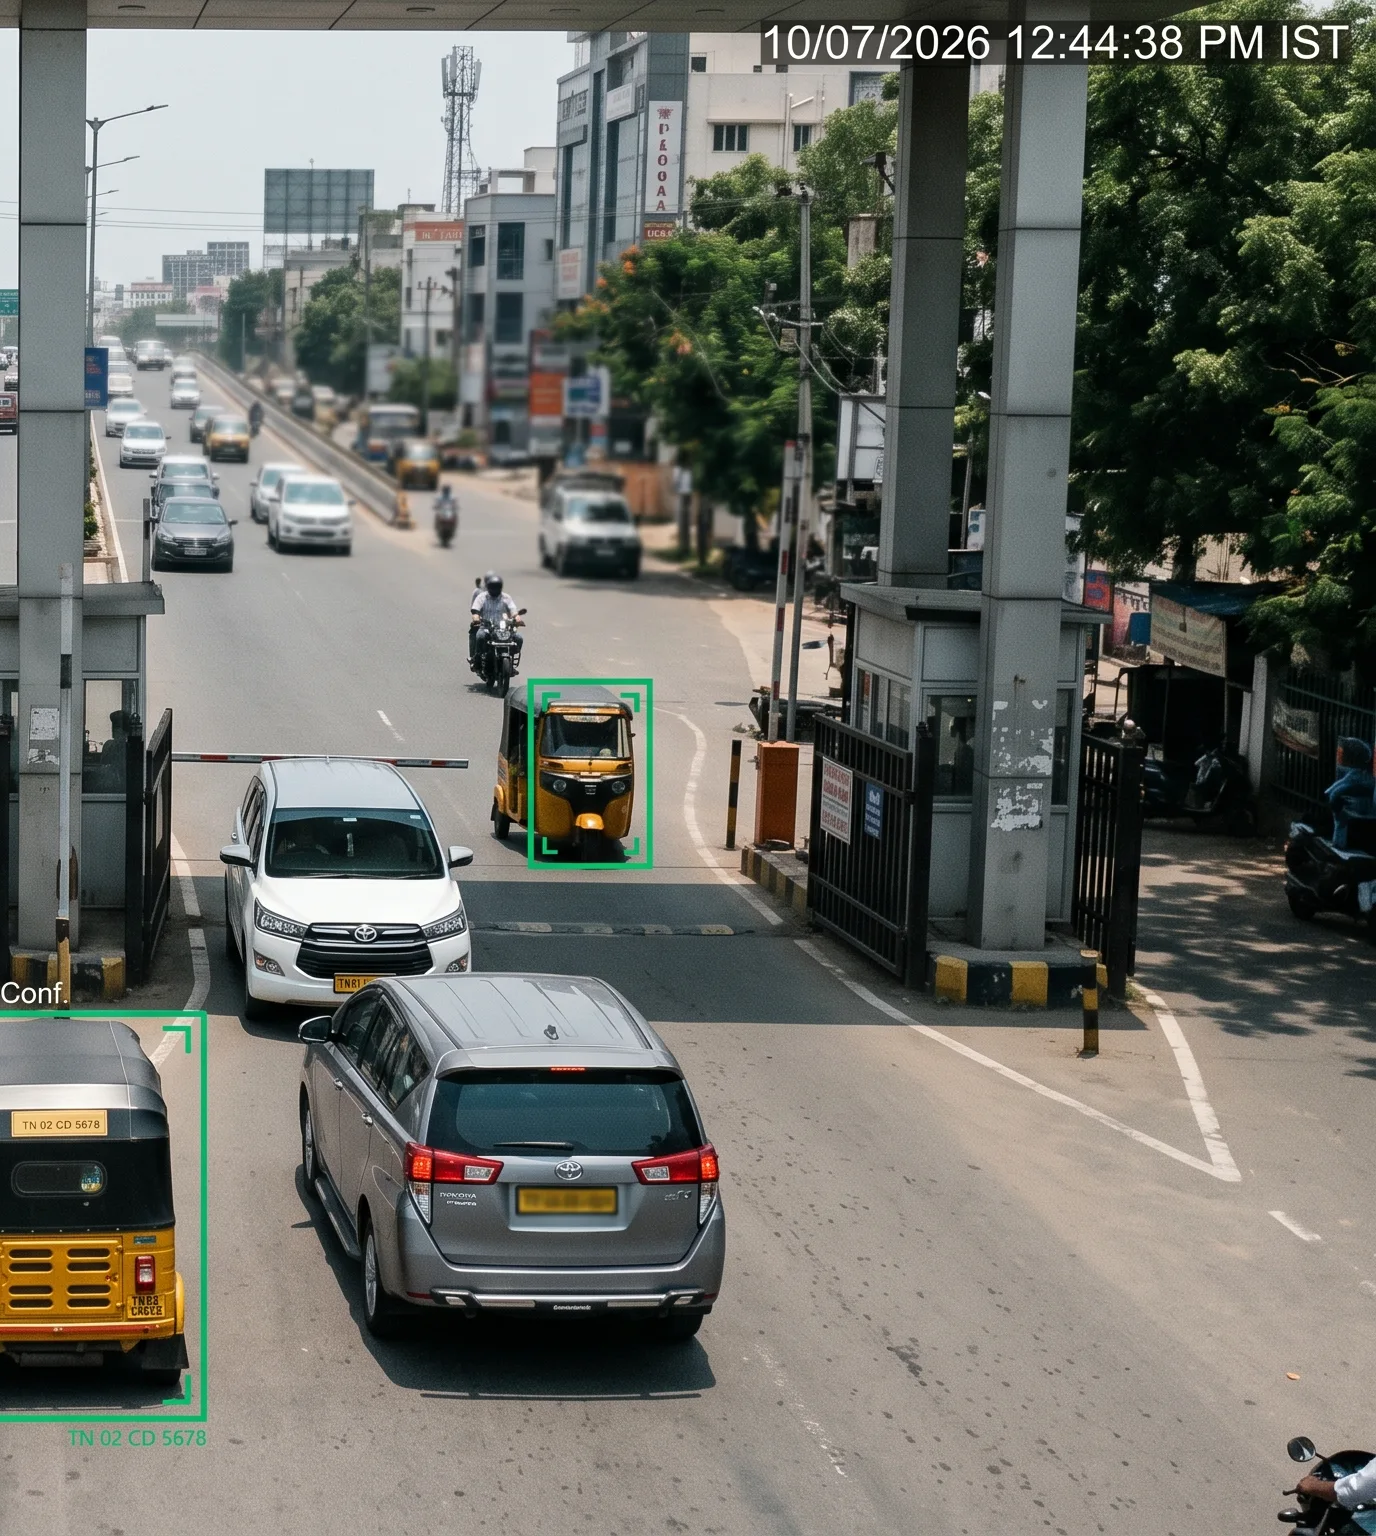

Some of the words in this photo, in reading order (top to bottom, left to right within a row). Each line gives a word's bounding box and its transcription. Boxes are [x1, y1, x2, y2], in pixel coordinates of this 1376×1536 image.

[22, 1121, 37, 1130] TN
[40, 1121, 53, 1130] 02
[56, 1120, 72, 1130] CD
[75, 1120, 101, 1129] 5678
